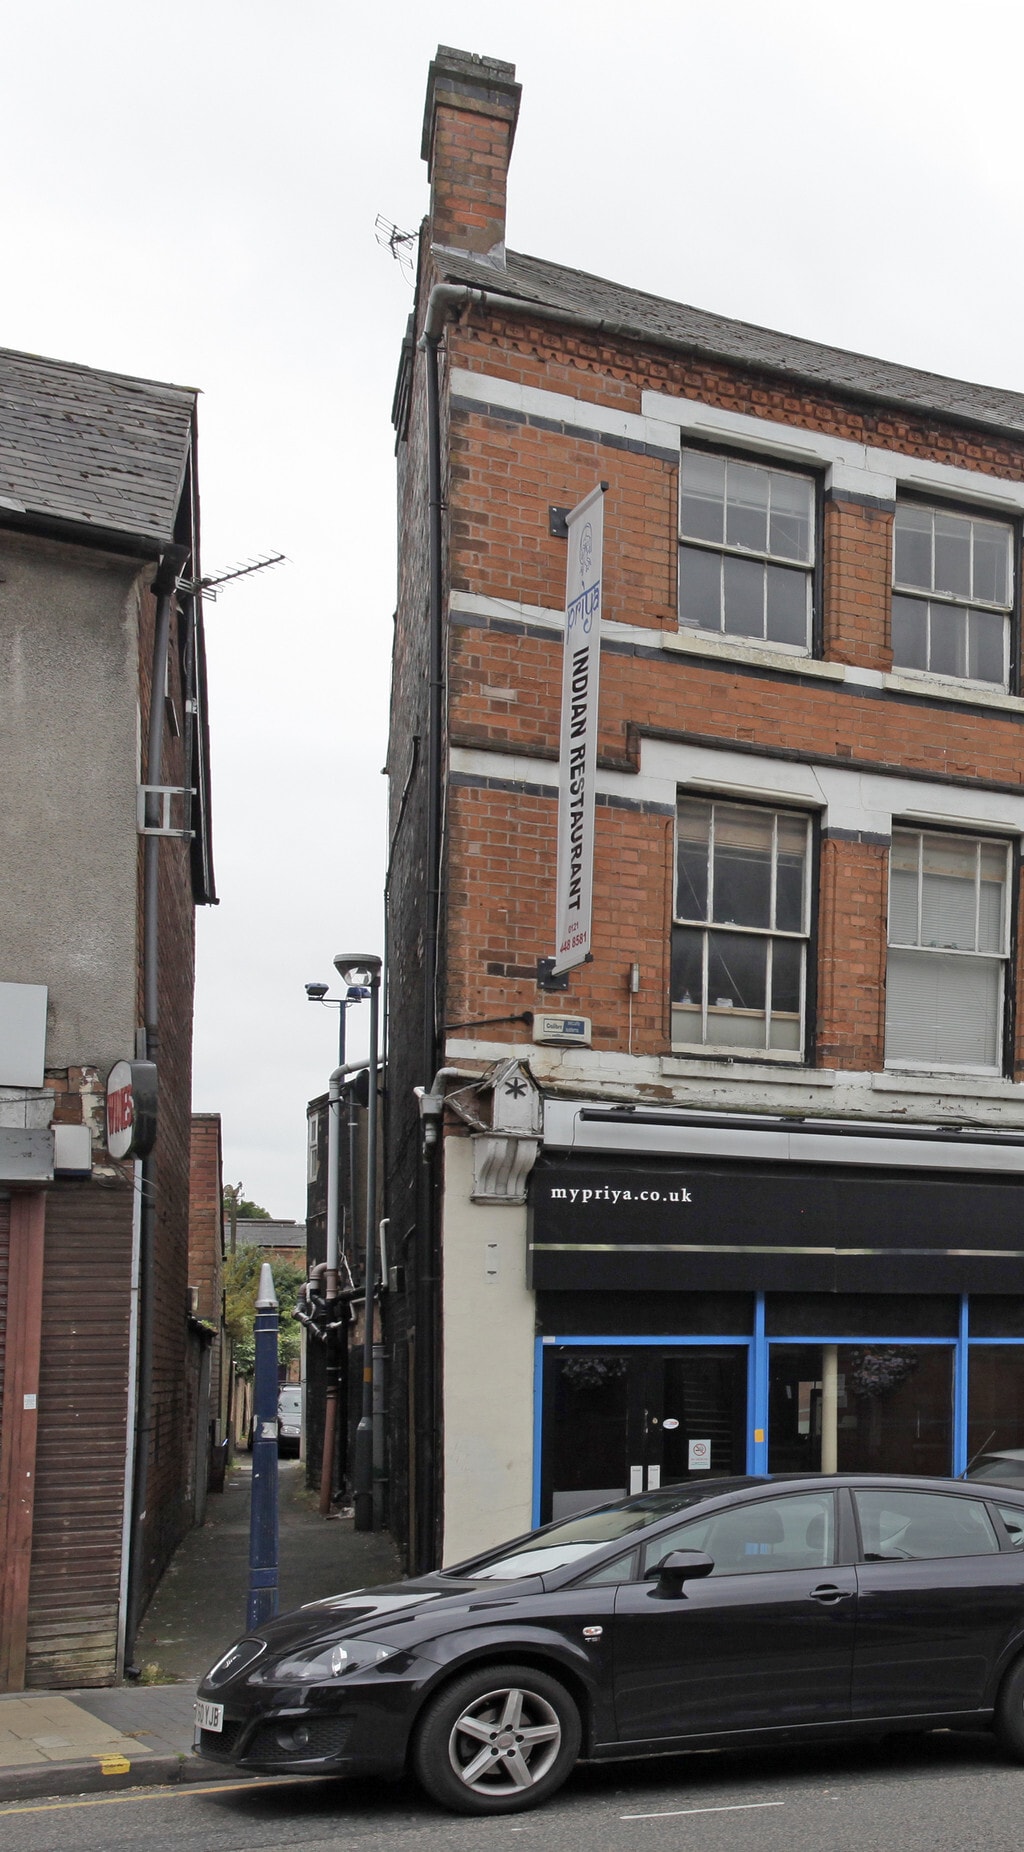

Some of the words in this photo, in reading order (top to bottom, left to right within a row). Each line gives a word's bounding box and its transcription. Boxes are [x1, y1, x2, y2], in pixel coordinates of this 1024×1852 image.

[567, 580, 600, 645] priya
[570, 646, 589, 739] INDIAN
[568, 742, 586, 911] RESTAURANT
[560, 939, 571, 953] 448
[572, 931, 587, 948] 8581
[568, 921, 579, 934] 0121
[551, 1185, 692, 1204] mypriya.co.uk
